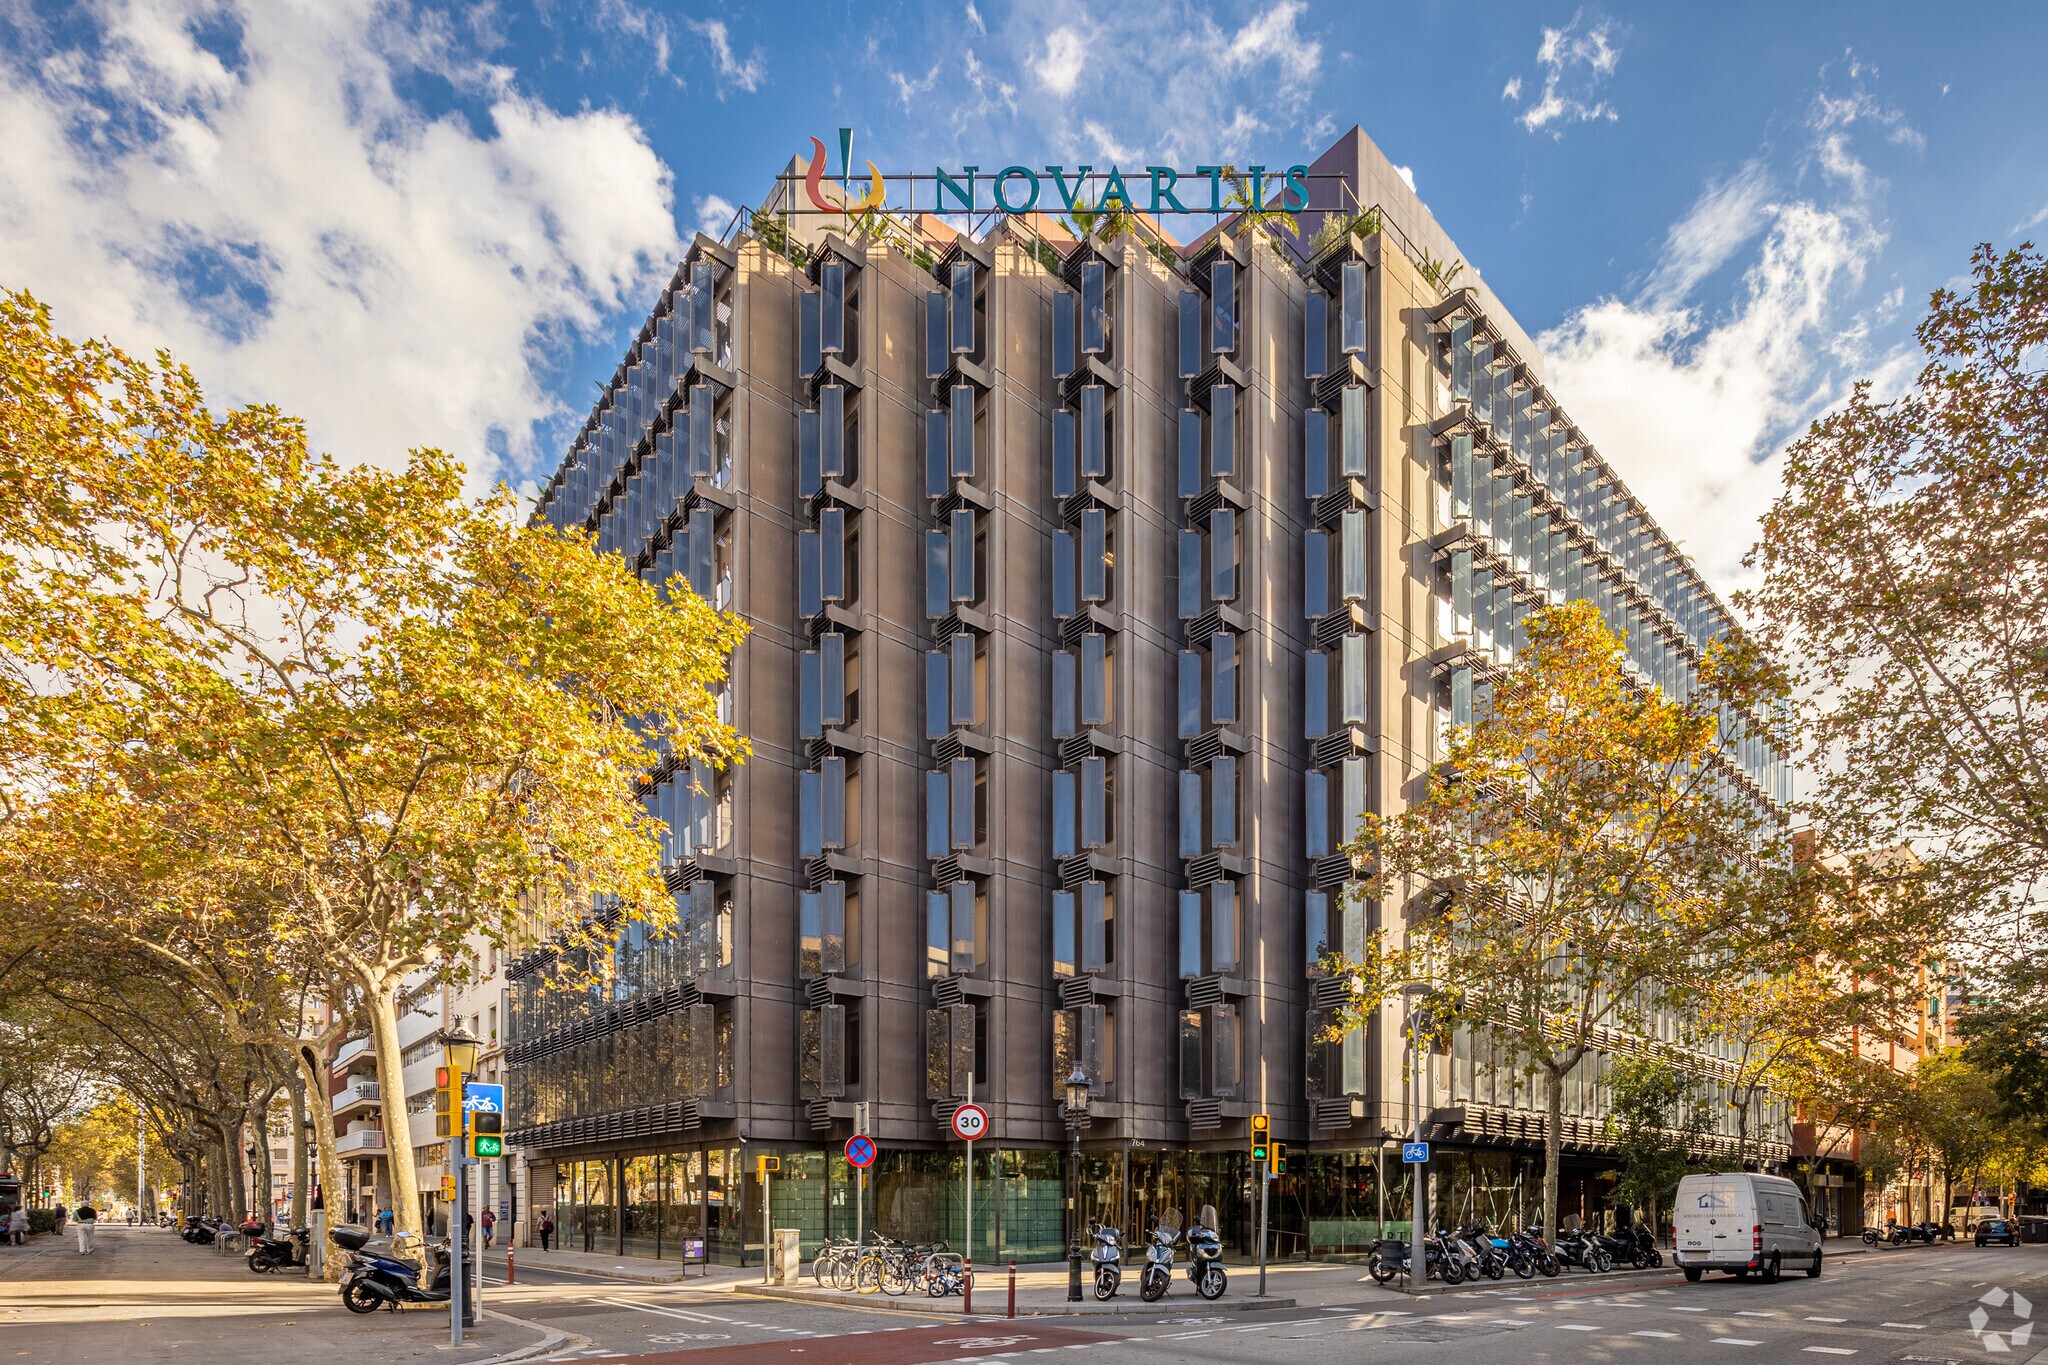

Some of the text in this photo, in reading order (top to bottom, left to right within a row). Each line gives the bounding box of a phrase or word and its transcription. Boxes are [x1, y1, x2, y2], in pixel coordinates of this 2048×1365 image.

[933, 164, 1309, 214] NOVARTIS
[960, 1116, 980, 1128] 30
[1131, 1138, 1145, 1147] 764
